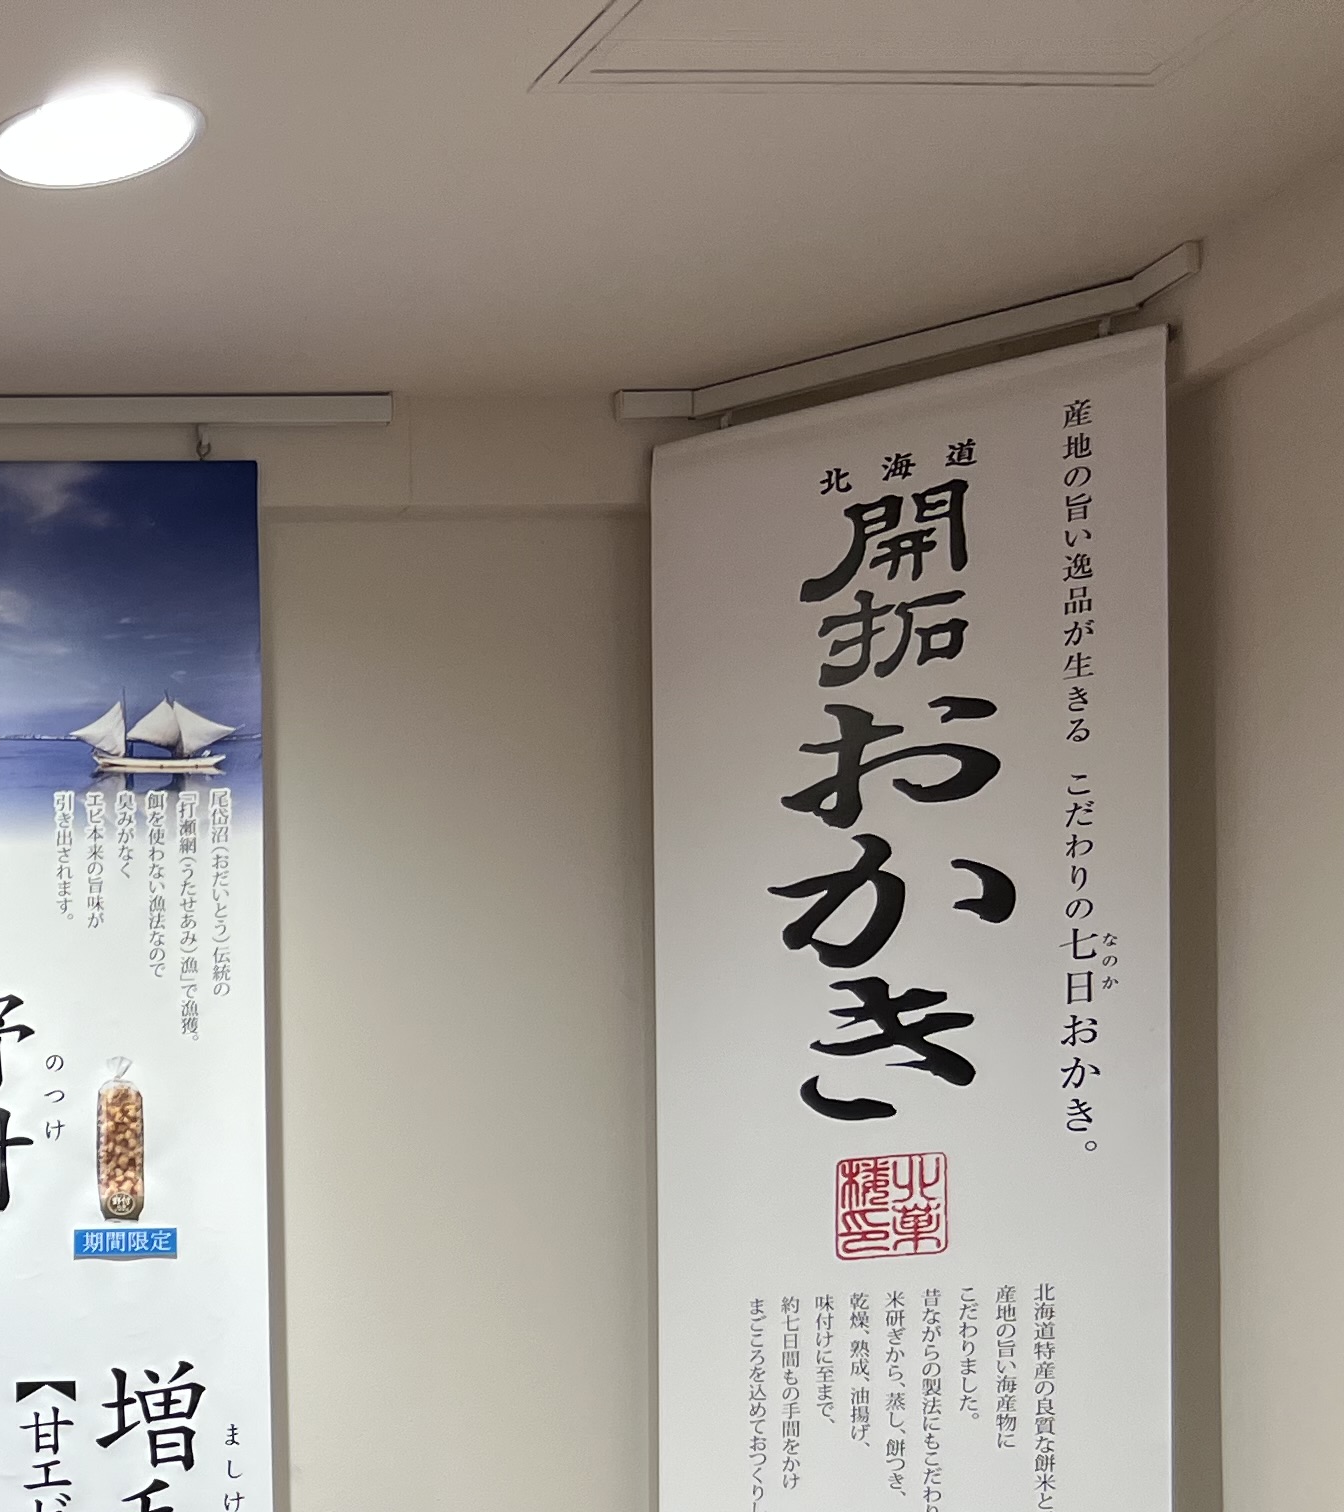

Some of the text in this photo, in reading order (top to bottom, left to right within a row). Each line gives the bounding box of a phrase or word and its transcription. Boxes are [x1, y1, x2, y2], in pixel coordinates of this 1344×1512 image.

[820, 441, 977, 496] 北海道
[118, 794, 134, 879] 臭みがなく
[768, 479, 1017, 1122] 開拓おかき
[1060, 398, 1100, 1152] 産地の旨い逸品が生きる こだわりの七日おかき。
[55, 793, 73, 921] 引き出されます。
[86, 794, 105, 929] エビ本来の旨味が
[147, 793, 166, 978] 餌を使わない漁法なので
[1102, 933, 1119, 988] なのか
[45, 1055, 65, 1141] のつけ
[81, 1231, 172, 1253] 期間限定
[781, 1297, 800, 1490] 約七日間もの手間をかけ
[815, 1294, 835, 1425] 味付けに至まで、
[850, 1293, 871, 1448] 乾燥、熟成、油揚げ、
[885, 1290, 907, 1497] 米研ぎから、蒸し、餅つき、
[959, 1287, 980, 1420] こだわりました。
[996, 1285, 1017, 1449] 産地の旨い海産物に
